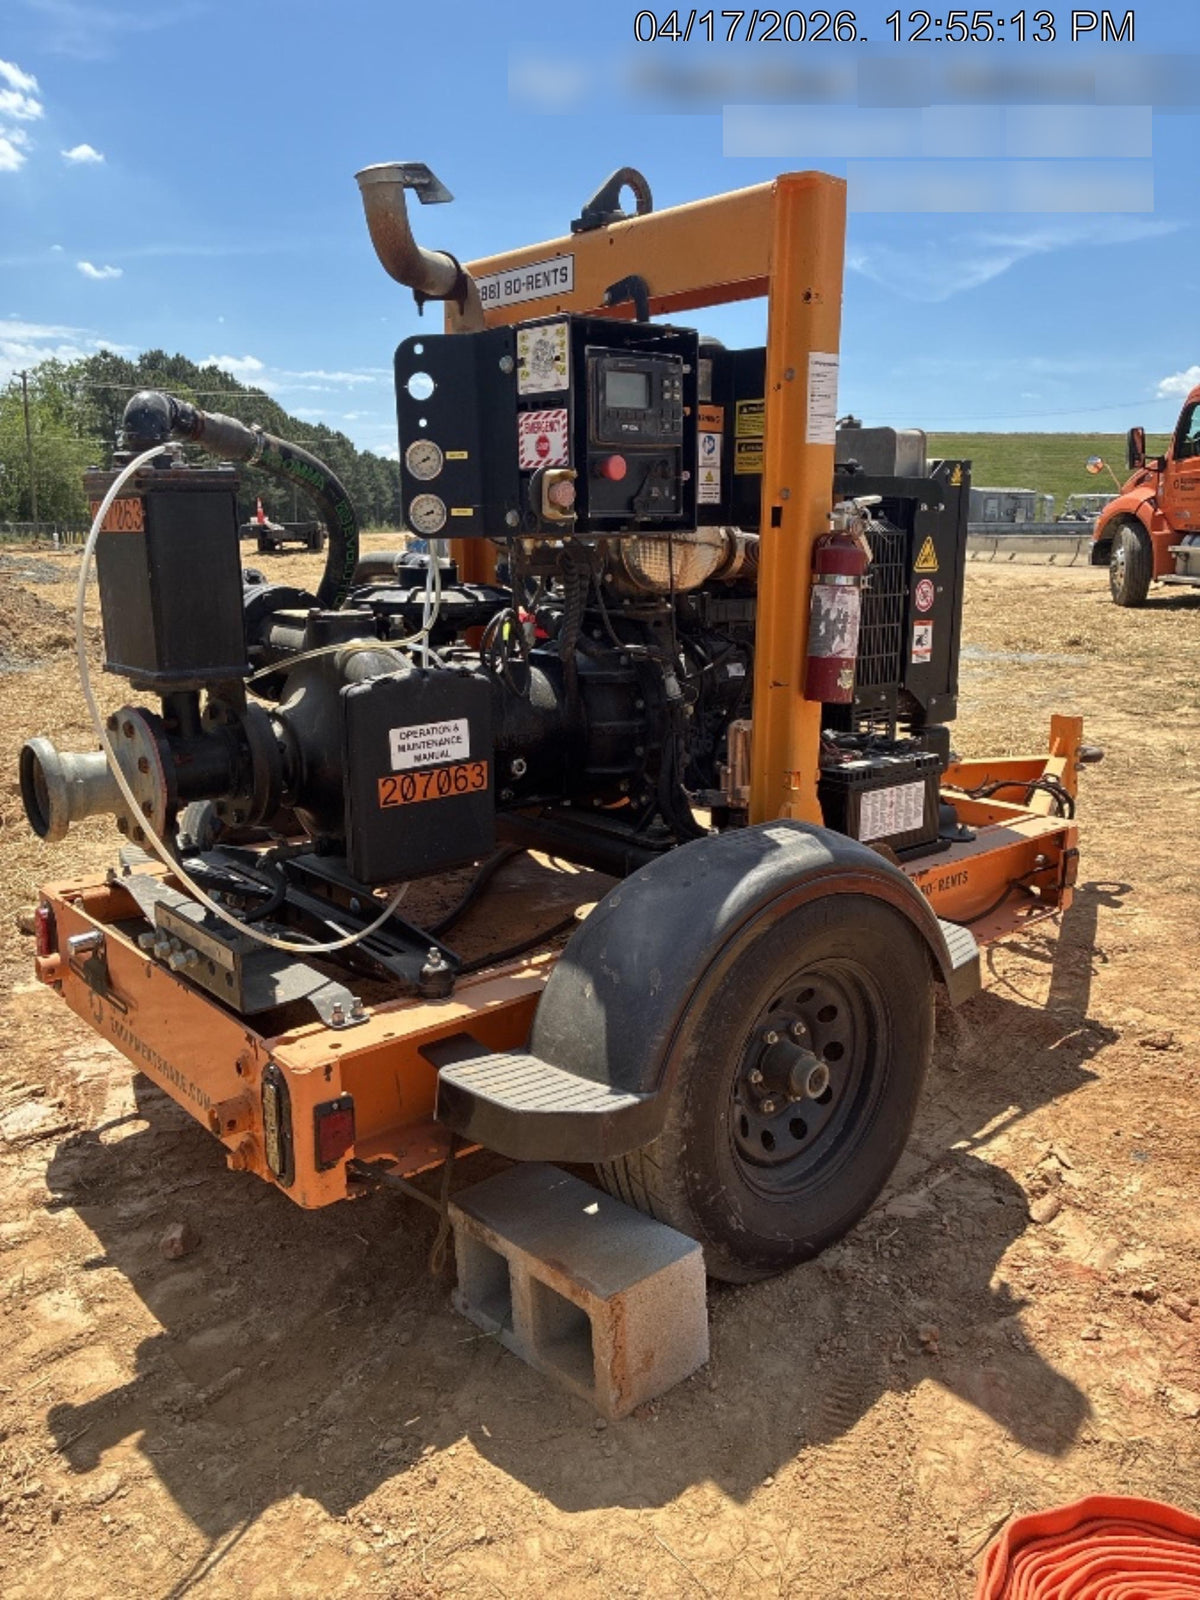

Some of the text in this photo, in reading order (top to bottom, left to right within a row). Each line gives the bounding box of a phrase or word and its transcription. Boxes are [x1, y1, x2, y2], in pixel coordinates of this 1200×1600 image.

[504, 266, 568, 296] 80-RENTS
[525, 420, 560, 434] EMERGENCY
[399, 725, 452, 741] OPERATION
[397, 735, 463, 753] MAINTENANCE
[413, 750, 452, 763] MANUAL
[381, 764, 485, 806] 207063
